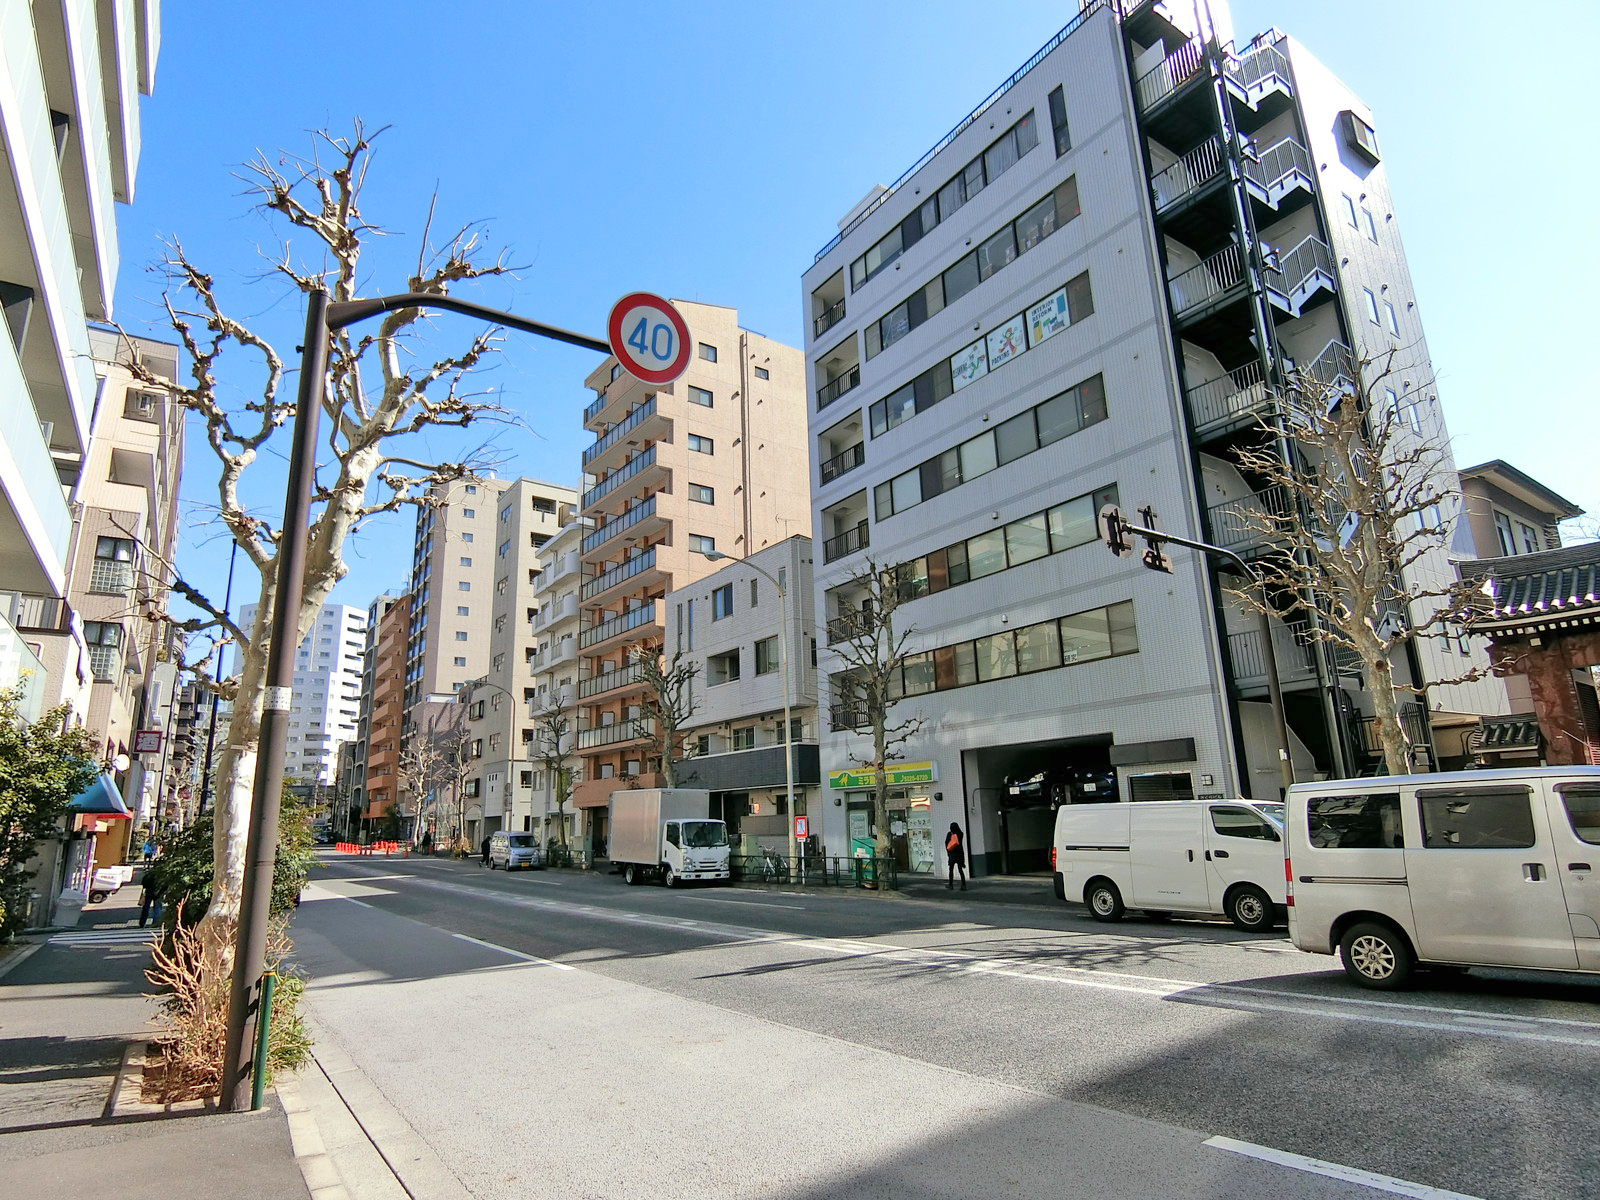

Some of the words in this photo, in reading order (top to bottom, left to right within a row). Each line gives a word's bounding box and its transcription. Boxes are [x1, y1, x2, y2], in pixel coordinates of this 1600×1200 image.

[1031, 299, 1055, 317] INTERIOR
[1032, 306, 1053, 323] REFORM
[628, 317, 673, 361] 40
[991, 350, 1010, 366] PACKING
[137, 733, 159, 751] 酒
